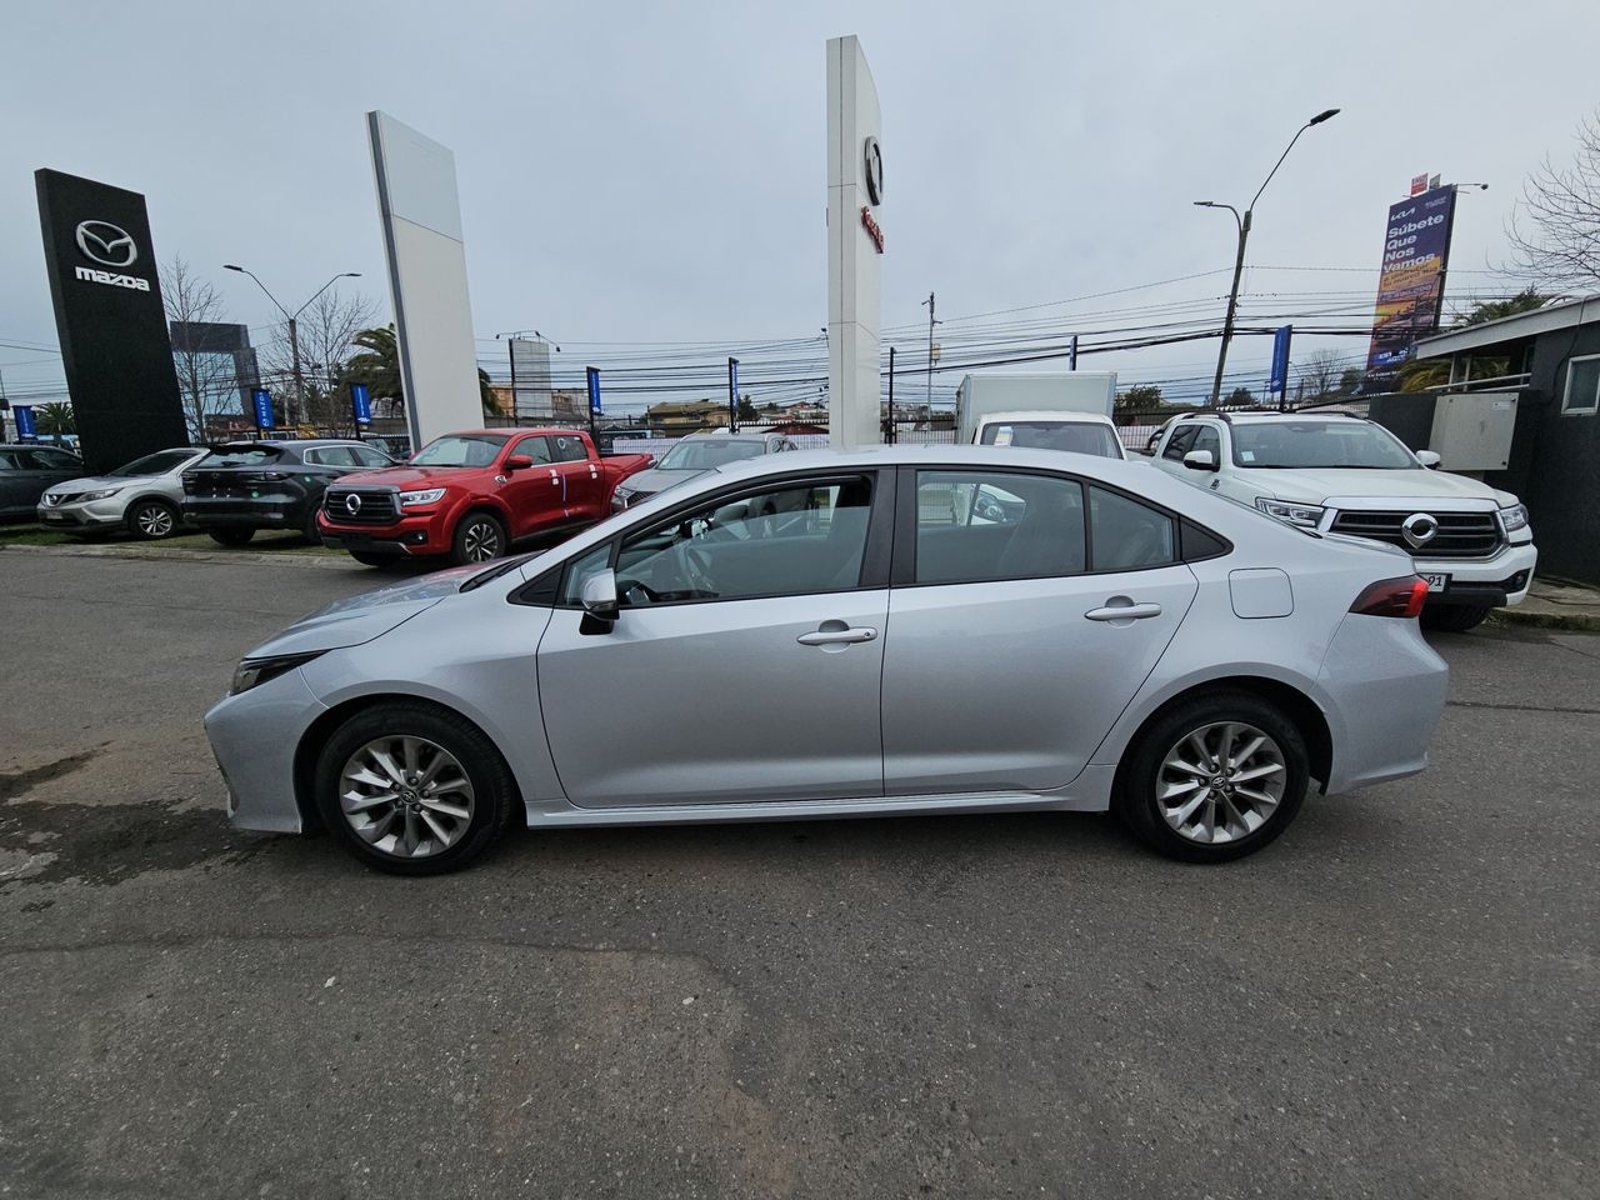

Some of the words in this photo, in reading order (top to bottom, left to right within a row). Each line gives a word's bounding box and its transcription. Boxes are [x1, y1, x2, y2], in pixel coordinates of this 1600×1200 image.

[1388, 214, 1444, 238] Súbete
[1386, 235, 1417, 250] Que
[1383, 253, 1435, 272] Vamos
[1384, 247, 1414, 262] Nos
